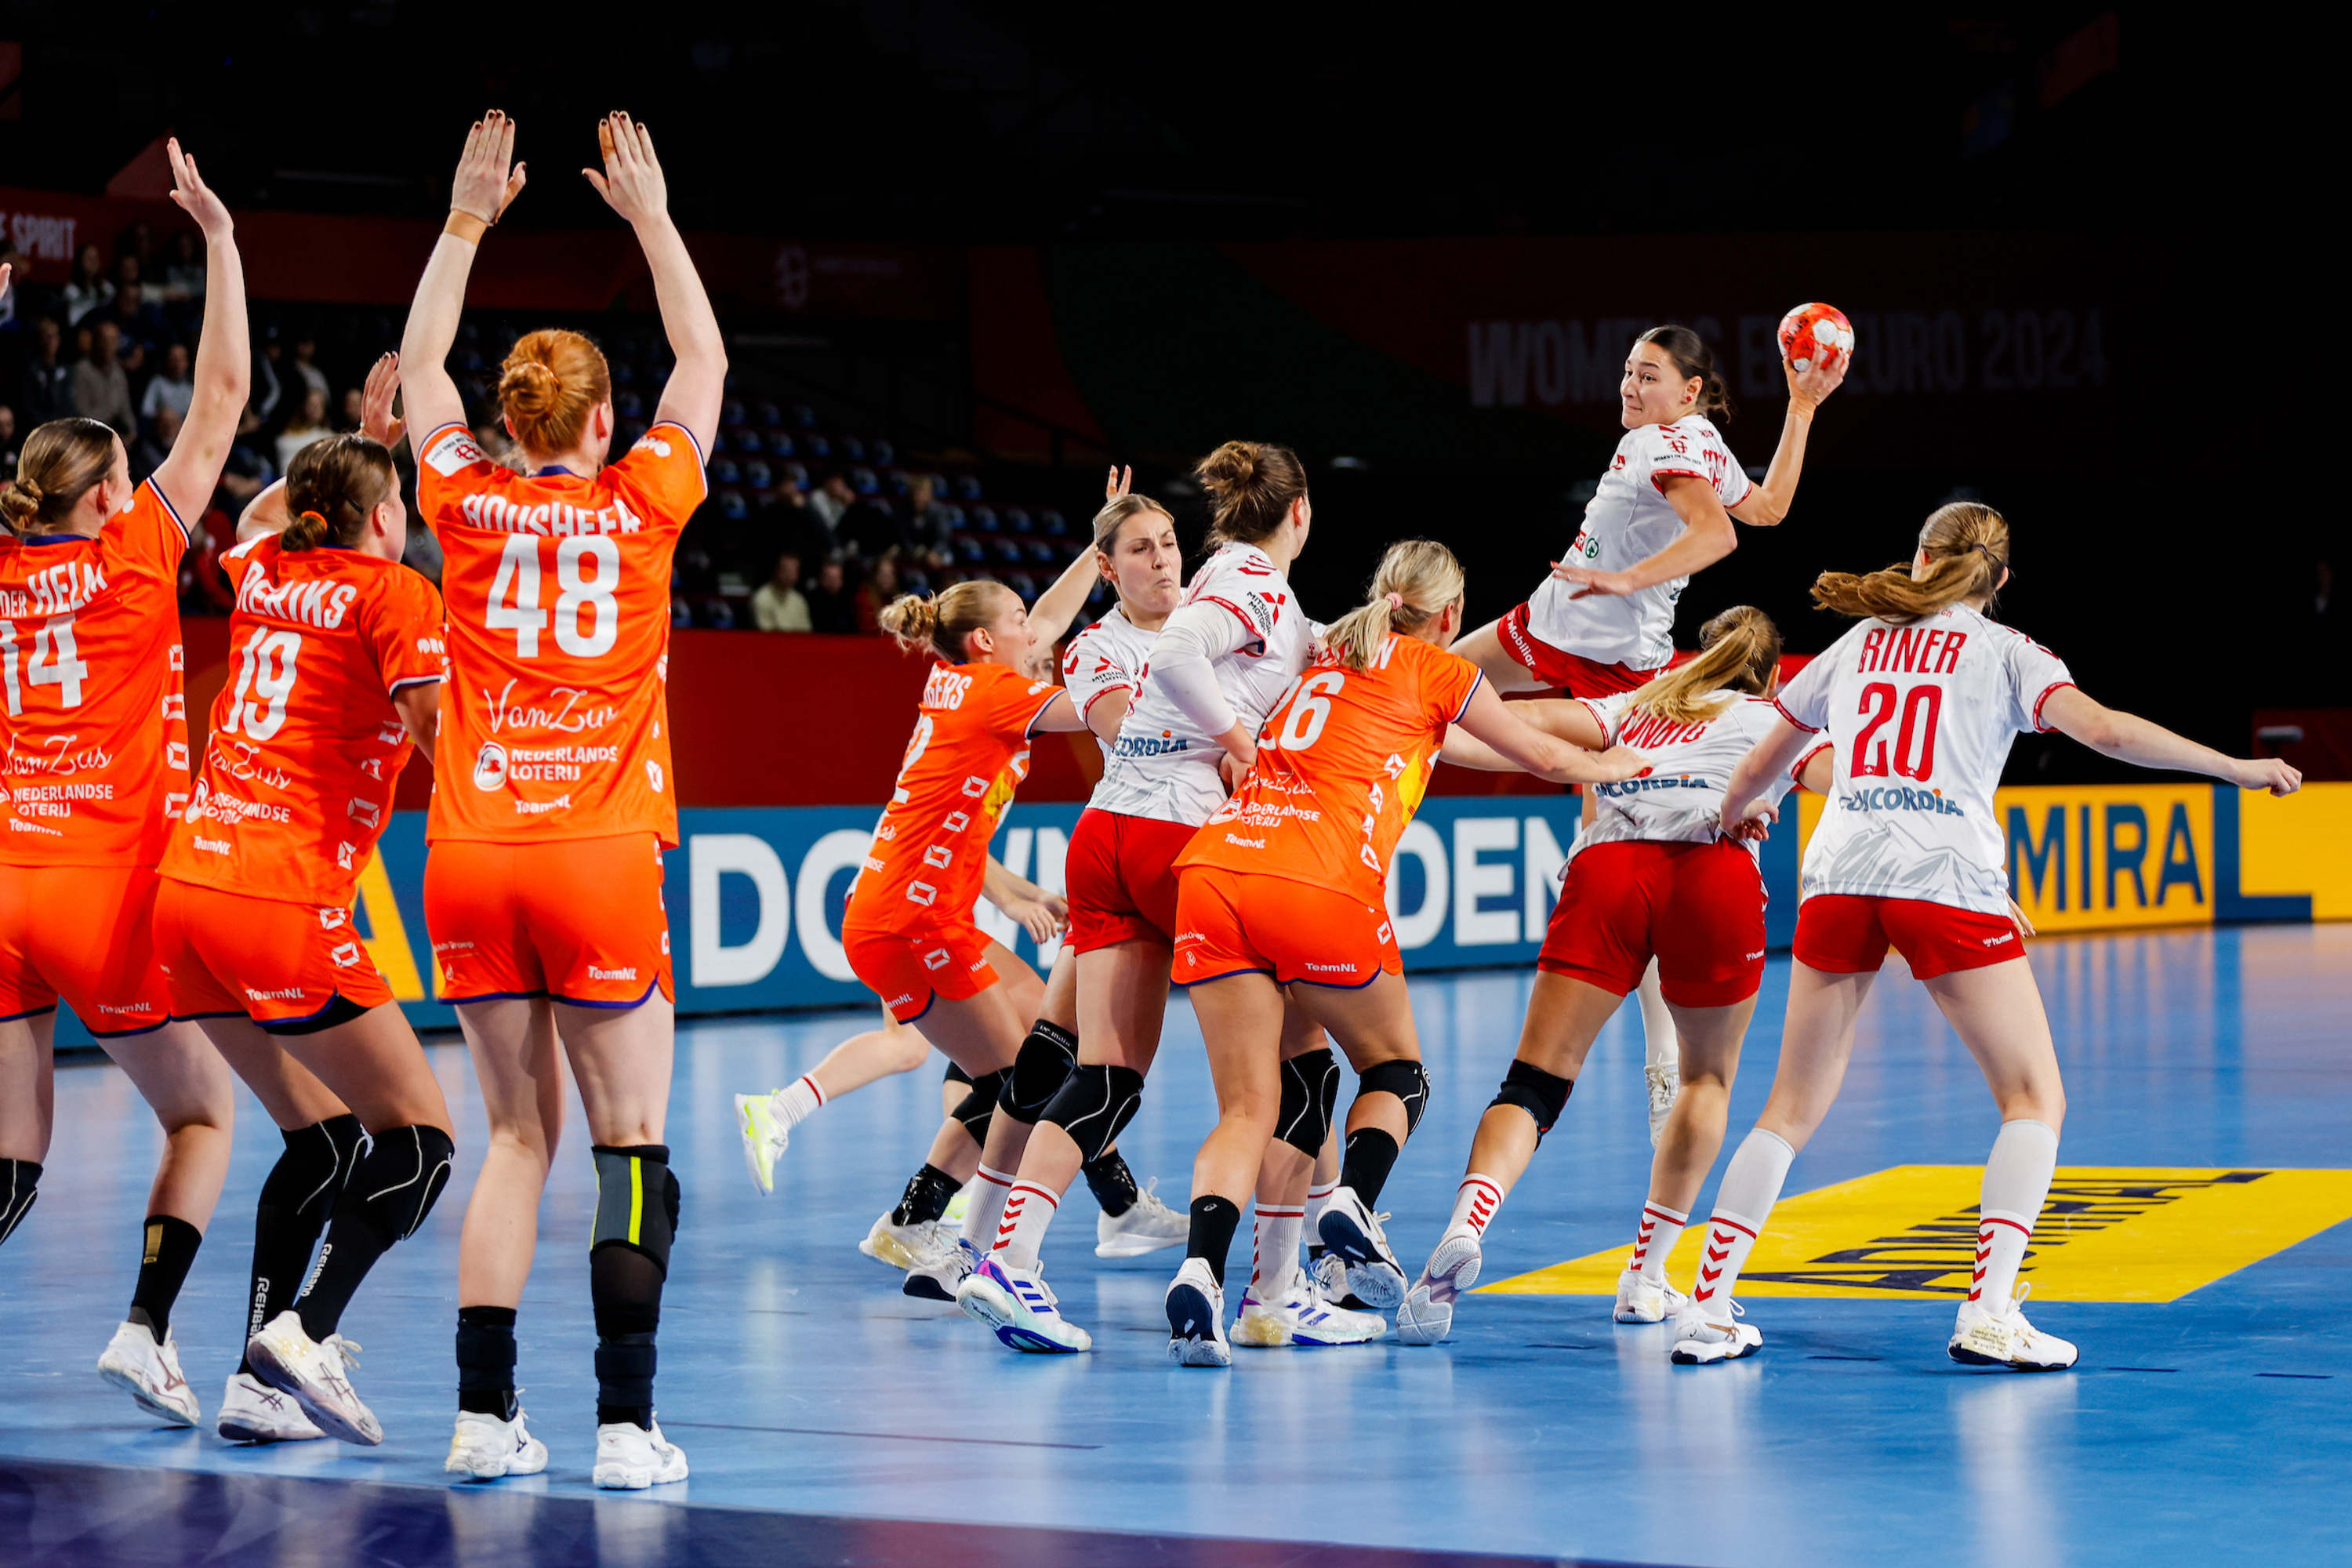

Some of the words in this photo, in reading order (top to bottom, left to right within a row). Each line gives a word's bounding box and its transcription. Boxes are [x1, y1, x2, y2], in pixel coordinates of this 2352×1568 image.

[1468, 314, 1722, 406] WOMES
[1979, 309, 2110, 390] 2024
[27, 561, 108, 615] HELM
[485, 532, 620, 658] 48
[1506, 620, 1537, 667] Mobiliar
[1857, 627, 1968, 674] RINER
[0, 615, 88, 716] 14
[222, 624, 303, 741] 19
[1850, 682, 1943, 782] 20
[510, 764, 581, 781] LOTERIJ
[12, 801, 71, 818] OTERIJ
[13, 784, 114, 804] NEDERLANDSE
[193, 835, 231, 855] TeamNL
[2007, 784, 2313, 925] MIRAL
[587, 964, 637, 981] TeamNL
[1305, 962, 1358, 973] TeamNL
[97, 1002, 152, 1014] TeamNL
[245, 987, 305, 1001] TeamNL
[887, 993, 914, 1009] amNL
